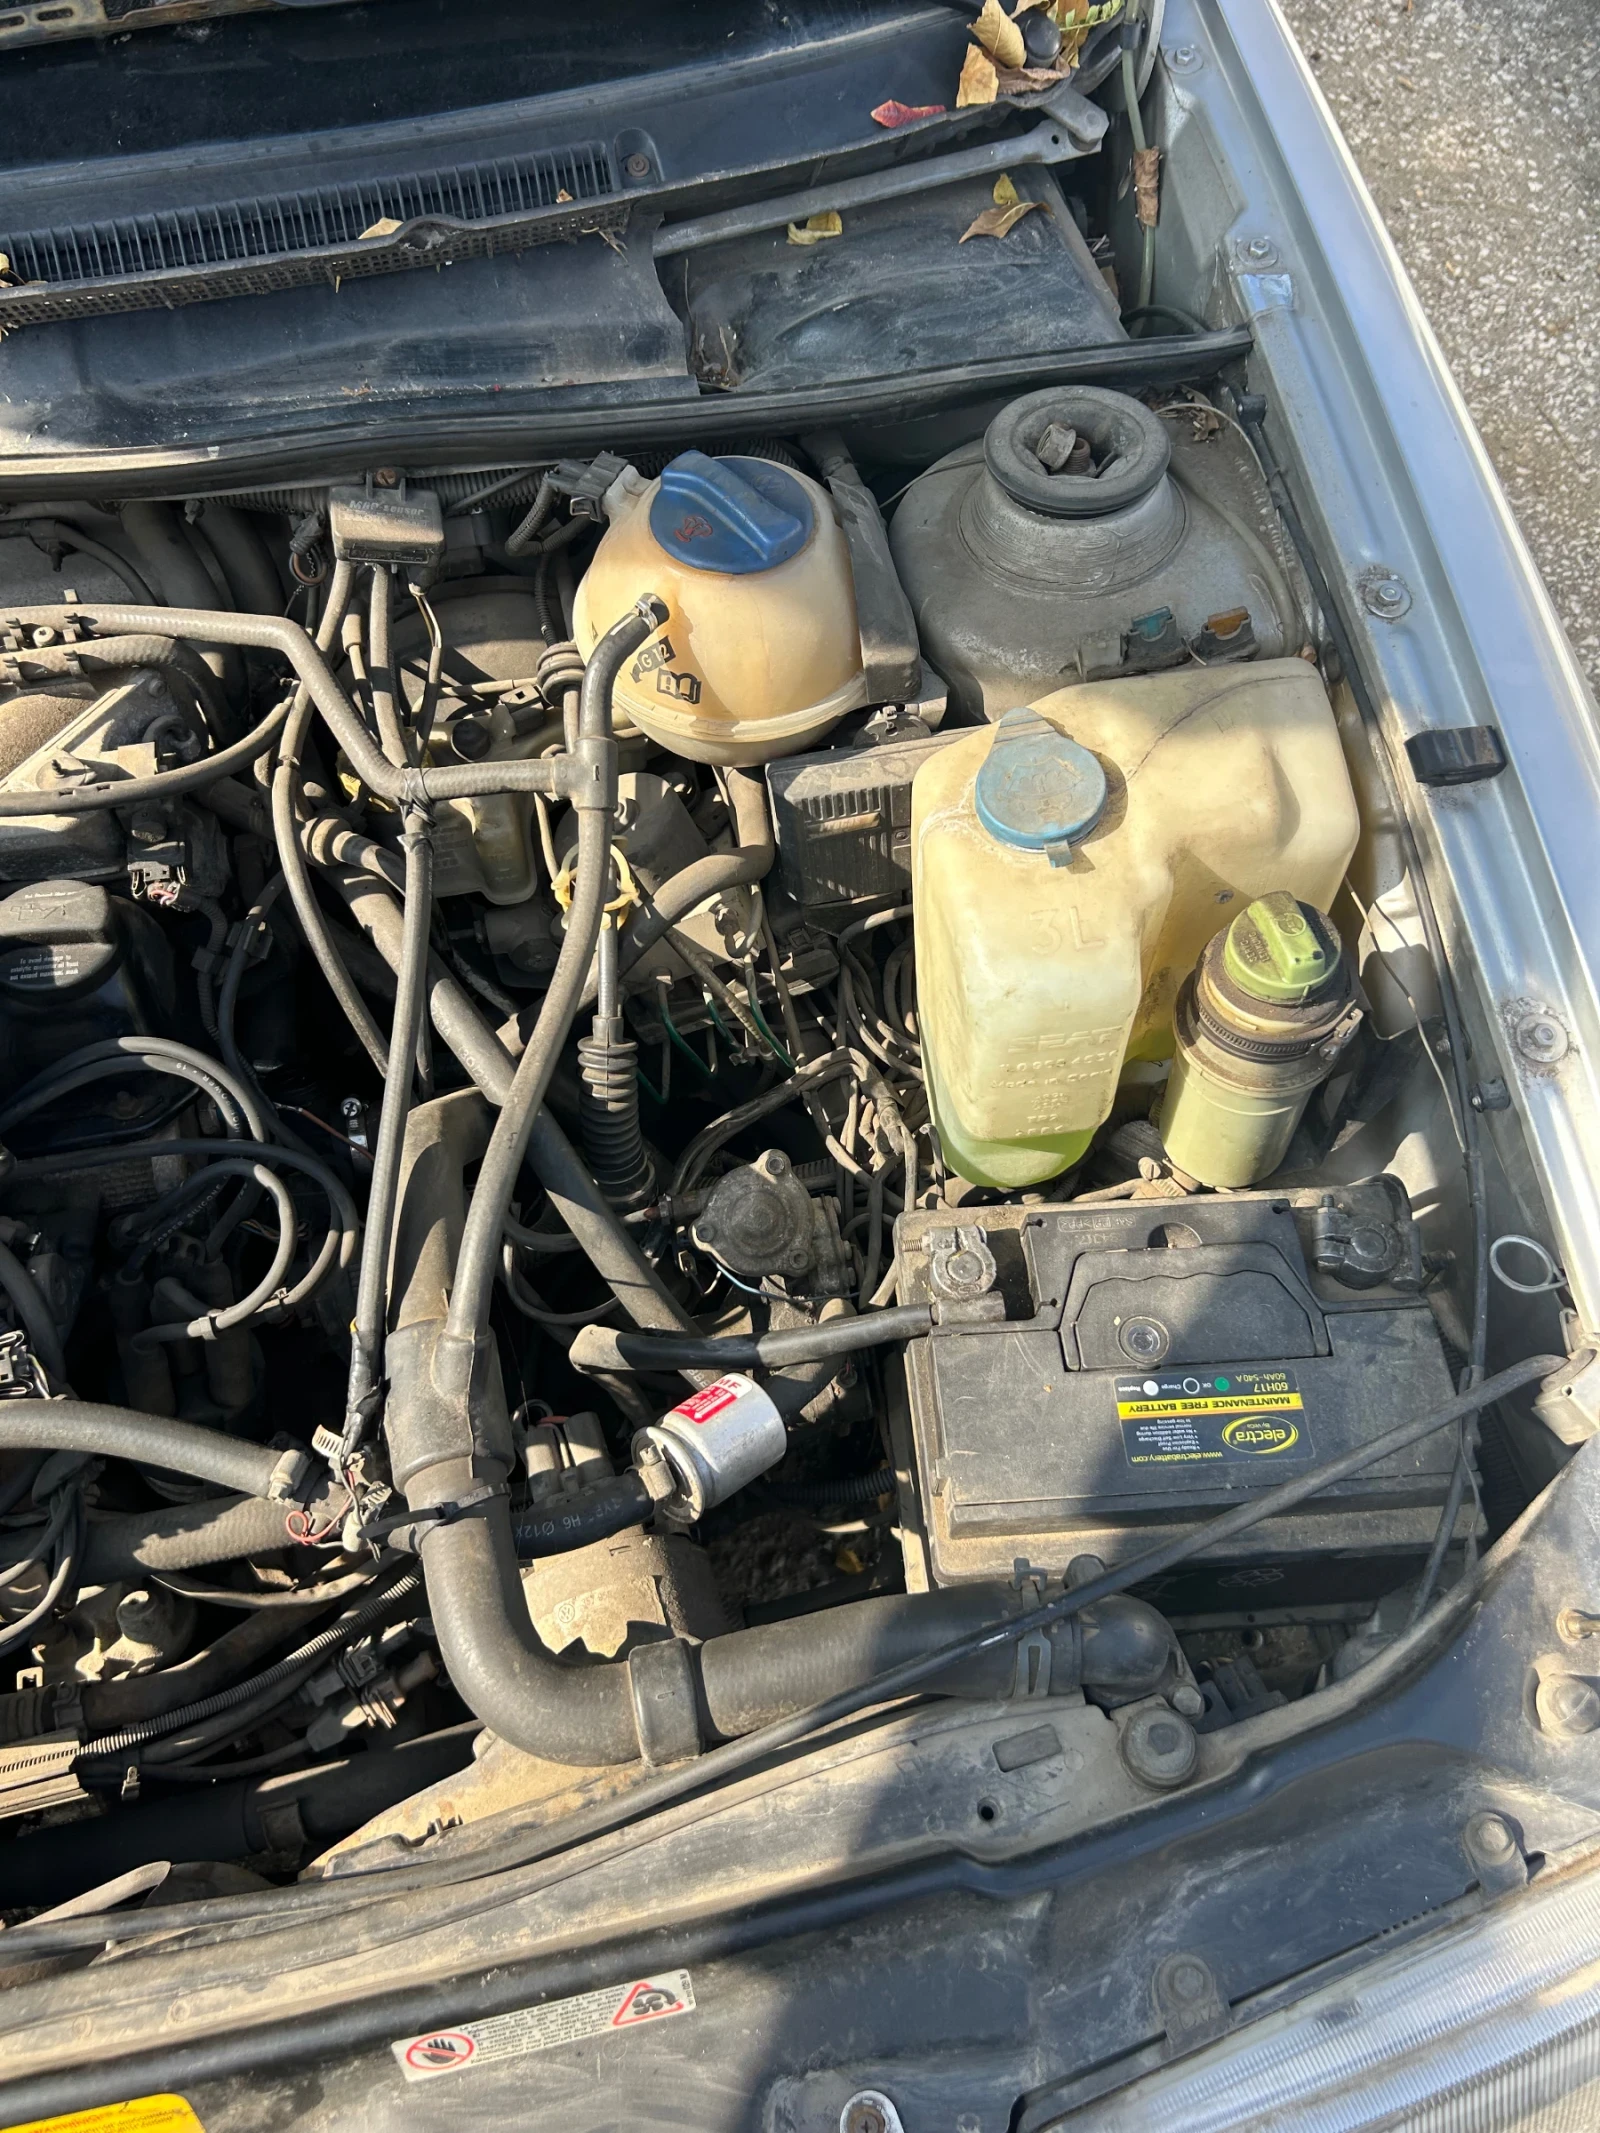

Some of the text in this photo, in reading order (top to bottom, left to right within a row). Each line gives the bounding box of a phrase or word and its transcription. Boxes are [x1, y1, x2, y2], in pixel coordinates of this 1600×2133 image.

[641, 644, 670, 668] G12
[1030, 906, 1105, 957] 3L
[1008, 1025, 1123, 1054] SEAT
[1253, 1381, 1287, 1391] 60H17
[1127, 1396, 1289, 1412] MAINTENANCE FREE BATTERY
[1235, 1428, 1285, 1443] electra
[1131, 1450, 1222, 1462] www.electrabattery.com
